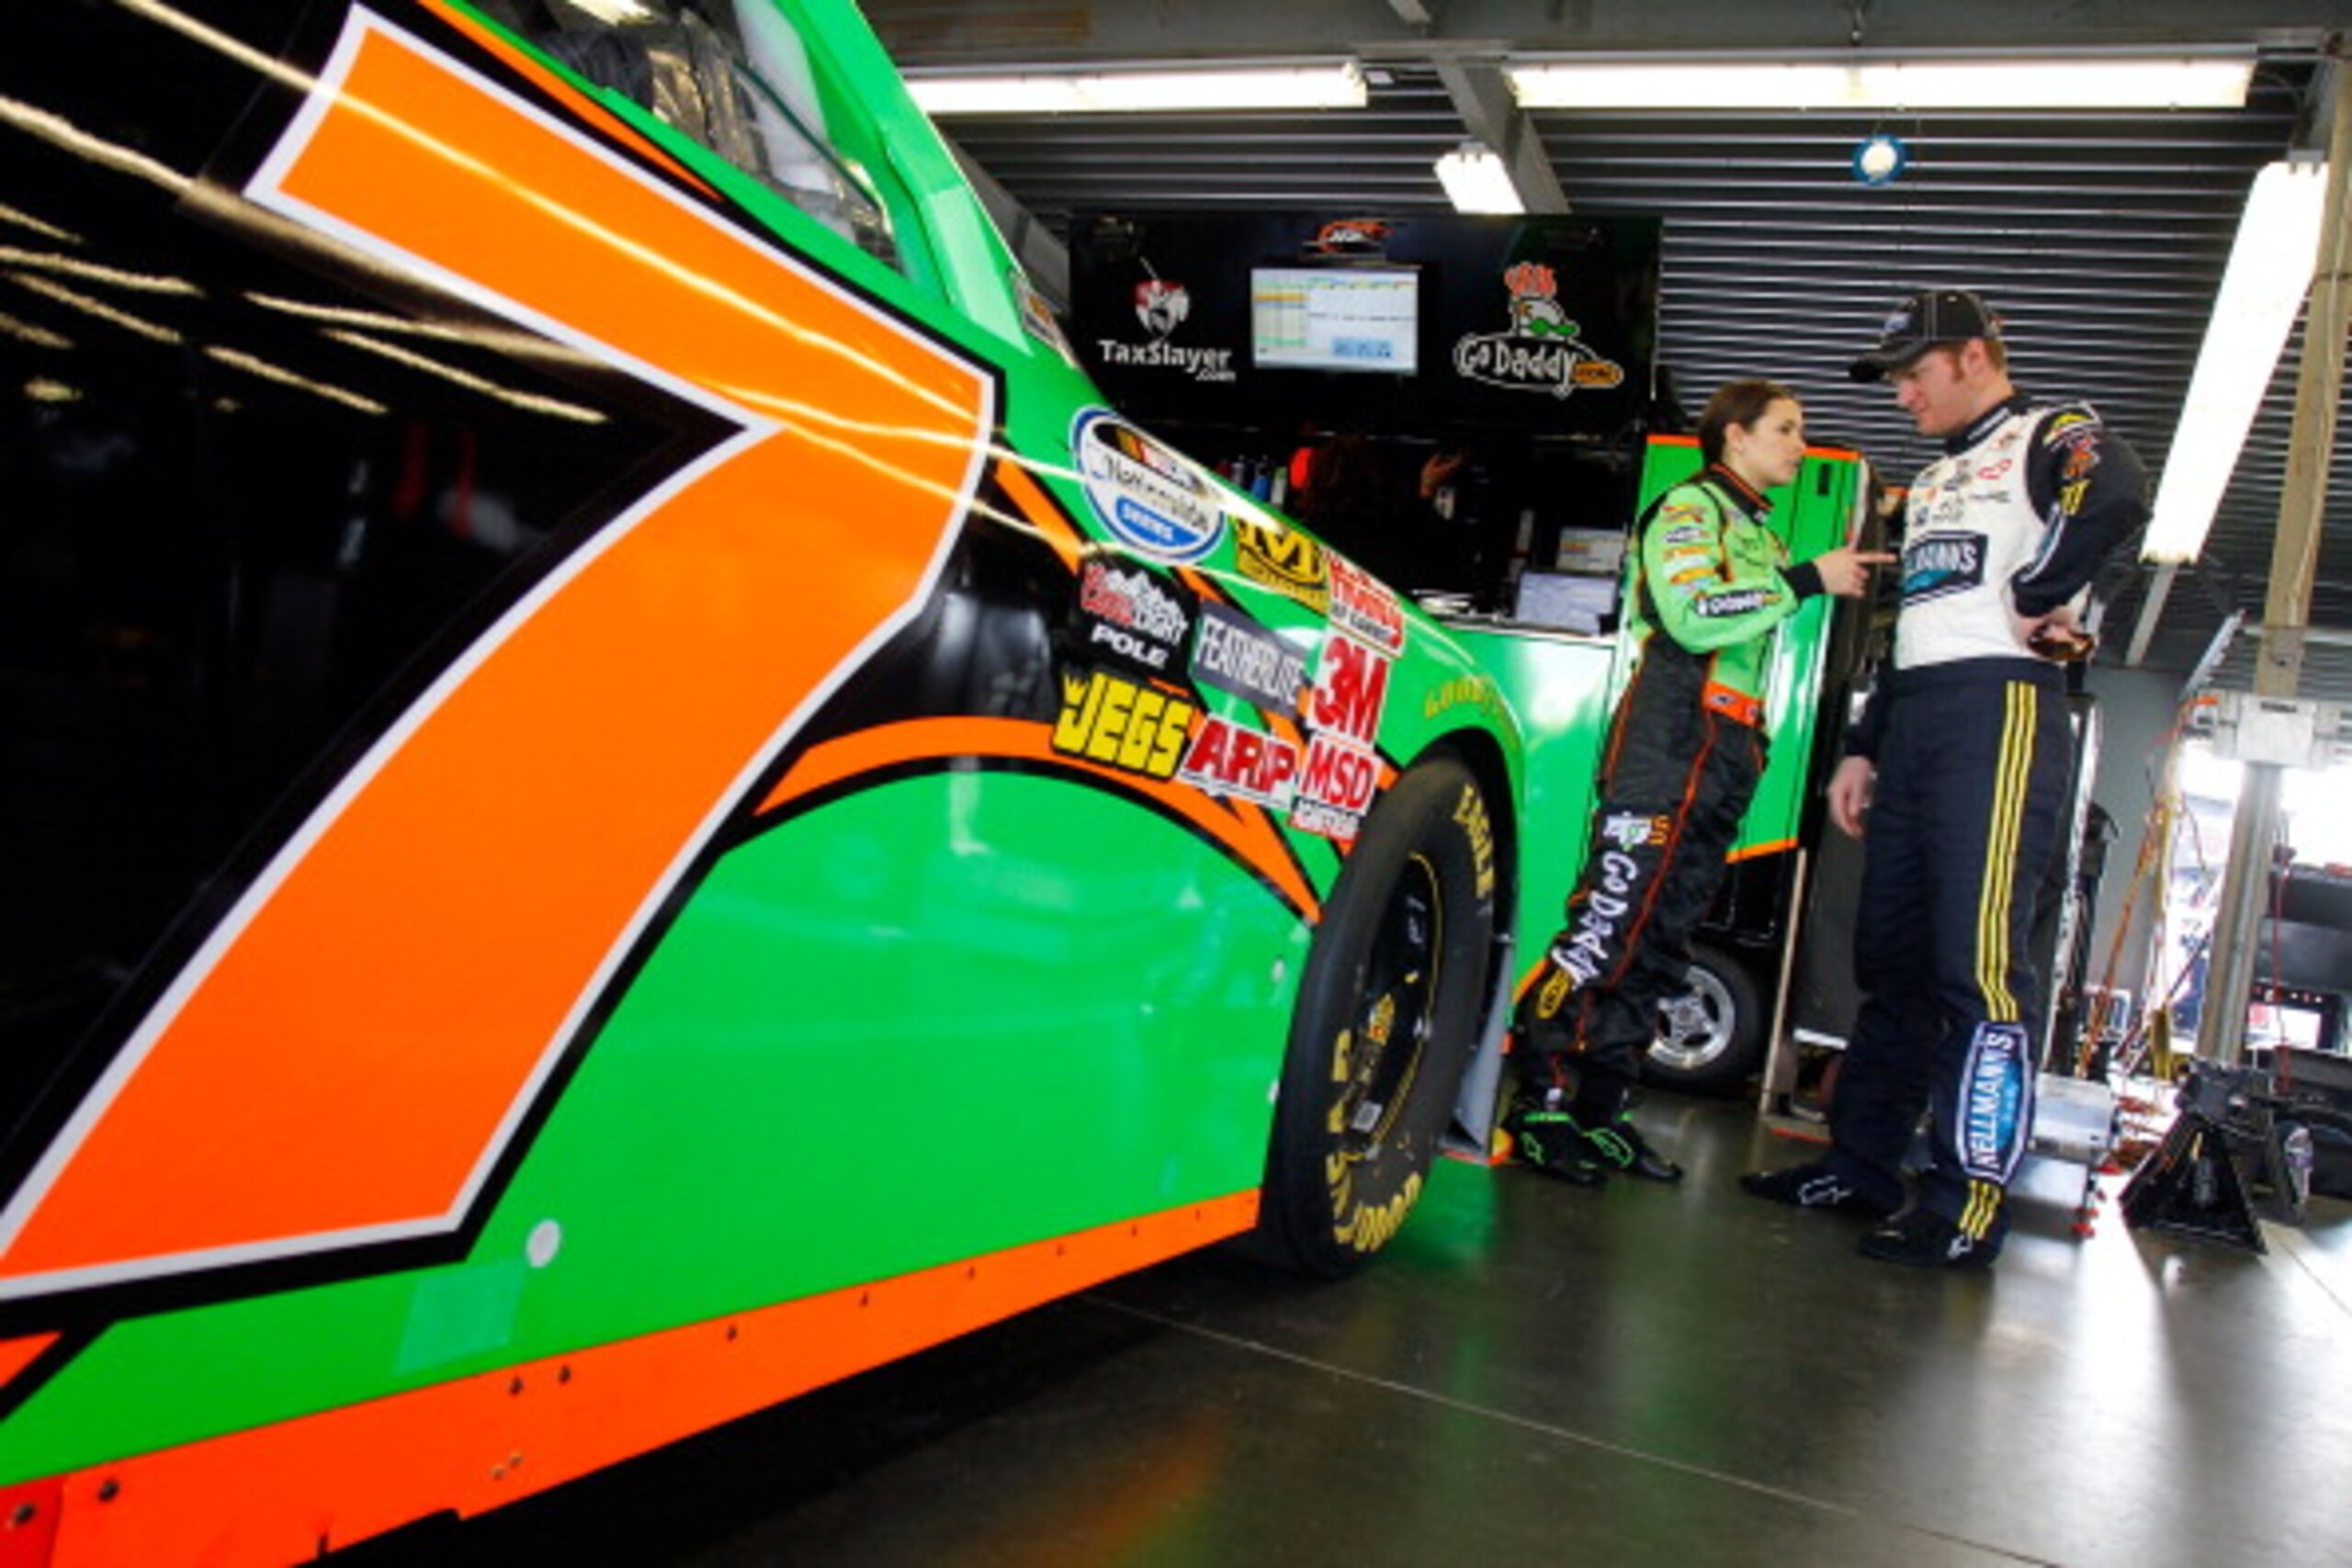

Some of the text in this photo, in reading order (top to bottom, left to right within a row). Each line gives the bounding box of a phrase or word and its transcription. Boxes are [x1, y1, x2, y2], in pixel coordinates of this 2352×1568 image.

[1097, 338, 1232, 374] TaxSlayer
[0, 2, 996, 1299] 7
[1091, 623, 1169, 669] POLE
[1053, 672, 1193, 778] JEGS
[1314, 637, 1388, 743] 3M
[1185, 719, 1297, 793] ARP
[1301, 739, 1374, 810] MSD
